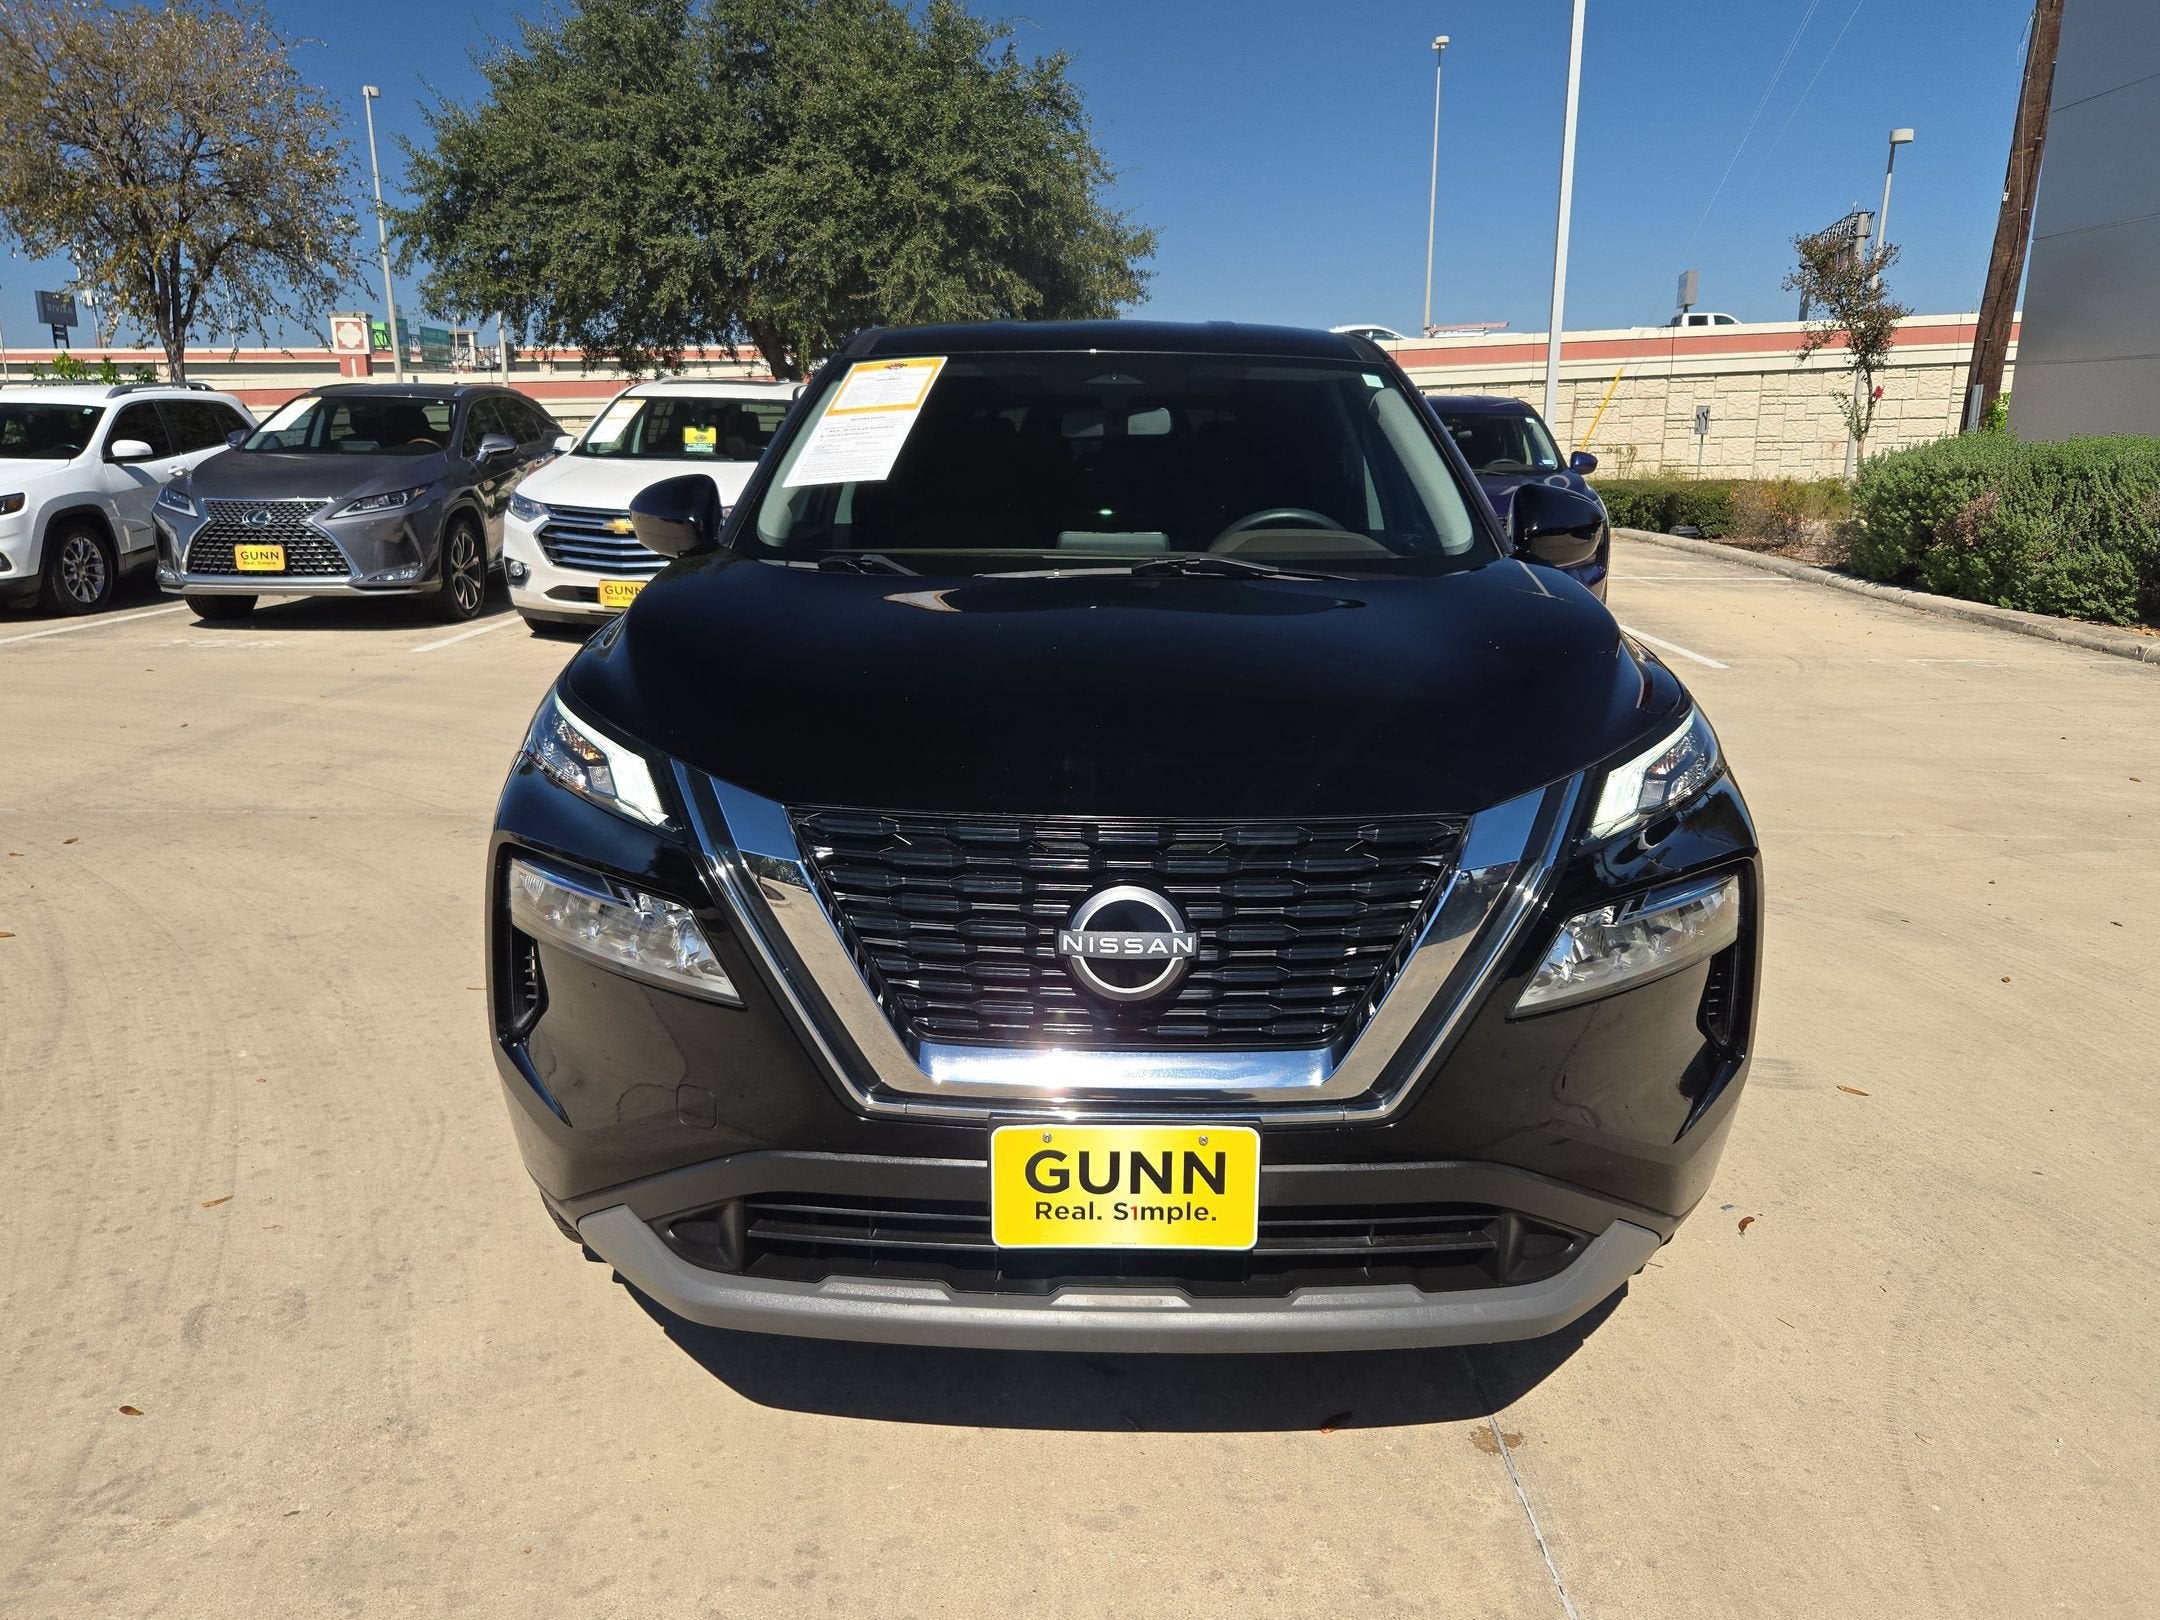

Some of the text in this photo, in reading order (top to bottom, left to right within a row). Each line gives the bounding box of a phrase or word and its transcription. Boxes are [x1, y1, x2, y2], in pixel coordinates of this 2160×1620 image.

[240, 551, 279, 561] GUNN
[1063, 935, 1193, 954] NISSAN
[1025, 1149, 1226, 1195] GUNN
[1035, 1201, 1102, 1221] Real.
